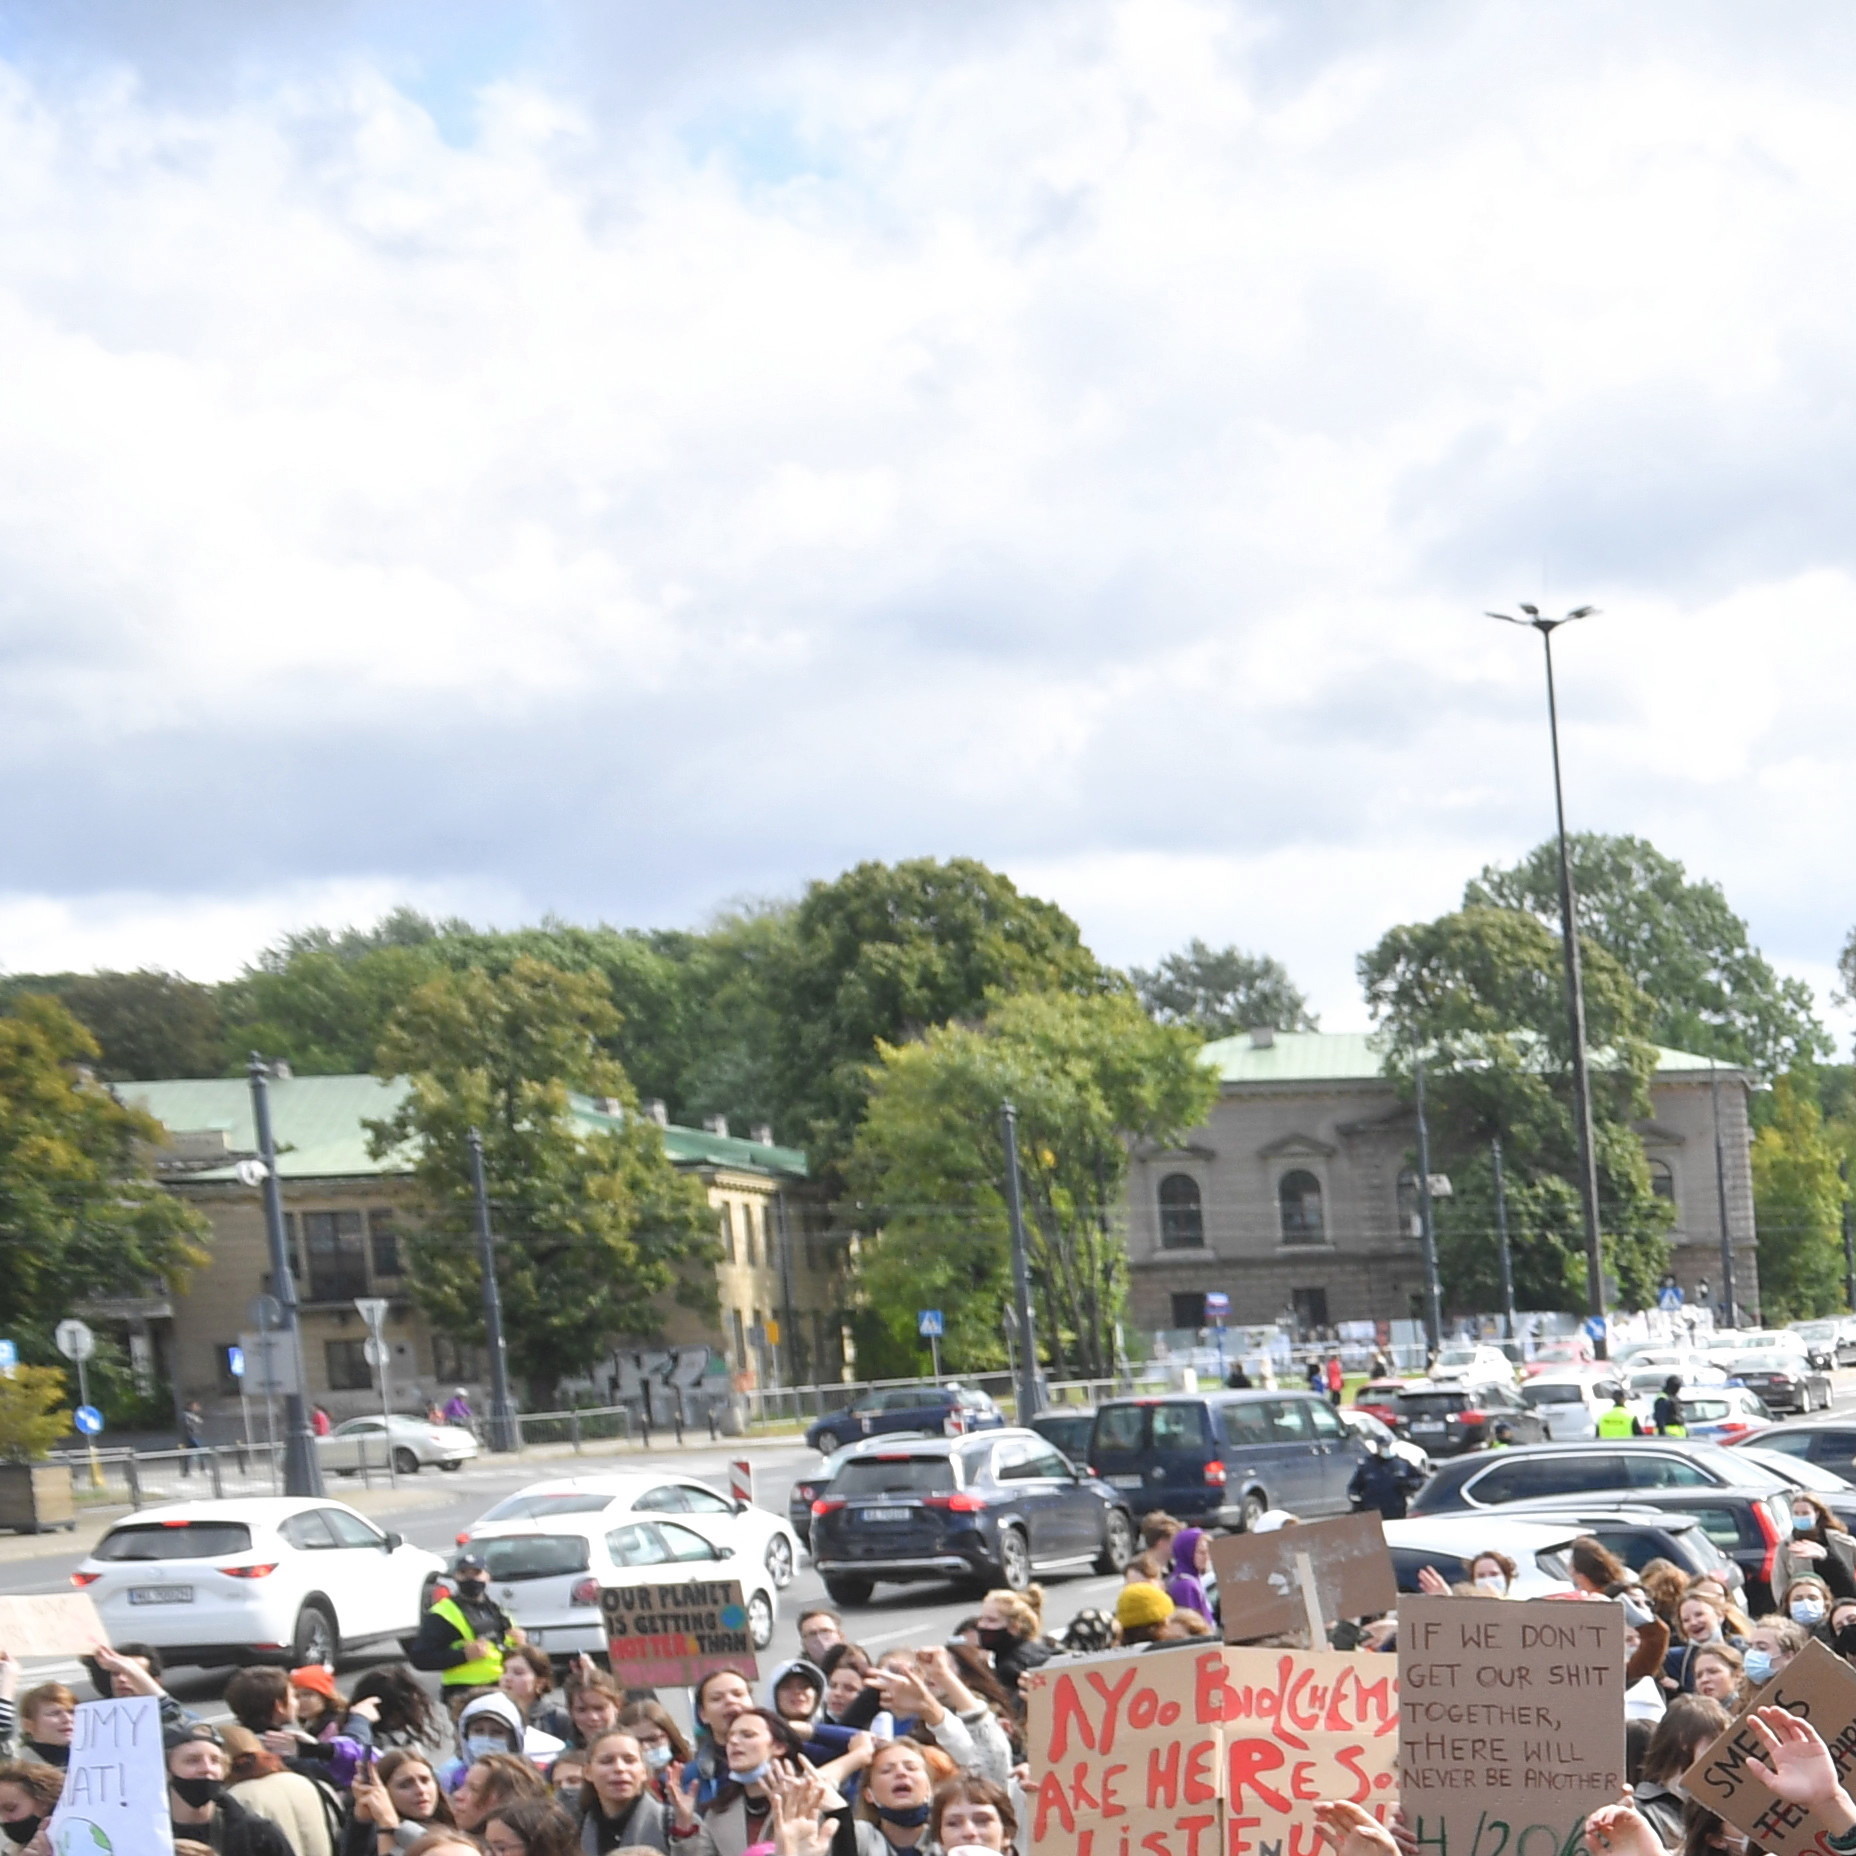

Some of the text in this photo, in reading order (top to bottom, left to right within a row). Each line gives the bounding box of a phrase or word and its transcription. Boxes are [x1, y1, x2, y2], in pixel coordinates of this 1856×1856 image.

[602, 1583, 731, 1611] OUR PLANET
[607, 1613, 716, 1635] IS GETTING
[1411, 1622, 1608, 1650] IF WE DON'T
[611, 1634, 746, 1659] HOTTER THAN
[1406, 1663, 1610, 1690] GET OUR SHIT
[1404, 1702, 1562, 1731] TOGETHER,
[1404, 1733, 1585, 1764] THERE WILL
[1704, 1689, 1810, 1799] SMES
[1034, 1762, 1128, 1842] ARE
[1147, 1738, 1320, 1814] HERE
[1403, 1768, 1618, 1791] NEVER BE ANOTHER
